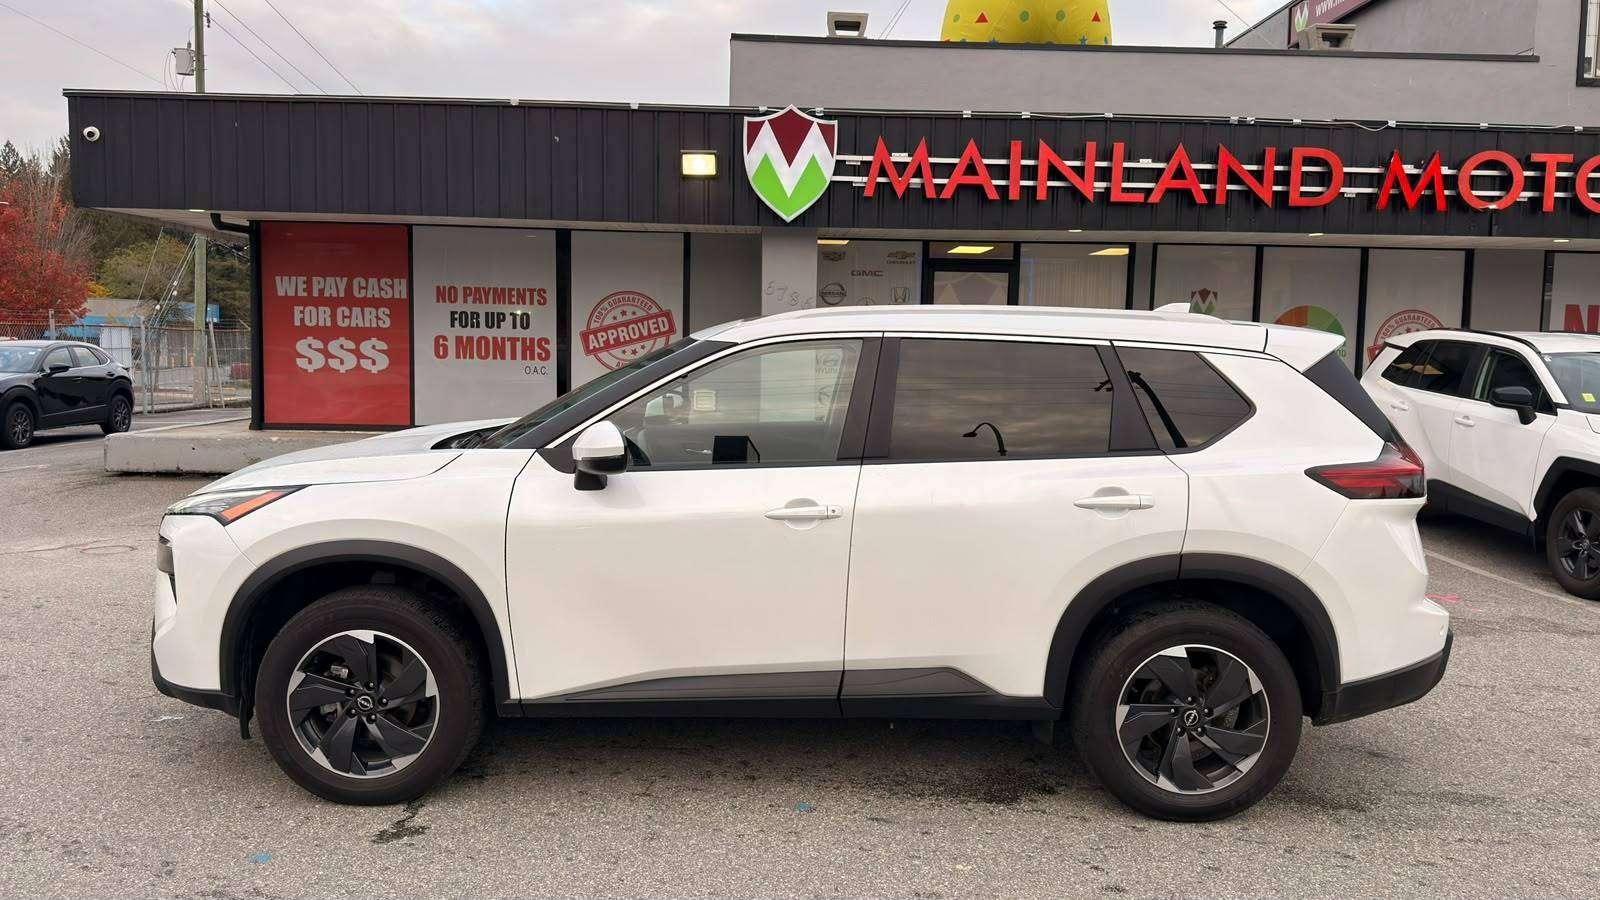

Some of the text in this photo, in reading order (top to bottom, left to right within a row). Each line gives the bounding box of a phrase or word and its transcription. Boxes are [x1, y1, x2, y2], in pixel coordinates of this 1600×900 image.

[863, 136, 1344, 208] MAINLAND
[850, 269, 884, 277] GMC
[275, 276, 407, 299] WE PAY CASH
[435, 286, 548, 306] NO PAYMENTS
[293, 306, 391, 328] FOR CARS
[450, 311, 531, 330] FOR UP TO
[588, 316, 670, 350] APPROVED
[295, 337, 390, 373] $$$
[433, 335, 551, 361] 6 MONTHS
[524, 366, 549, 376] O.A.C.
